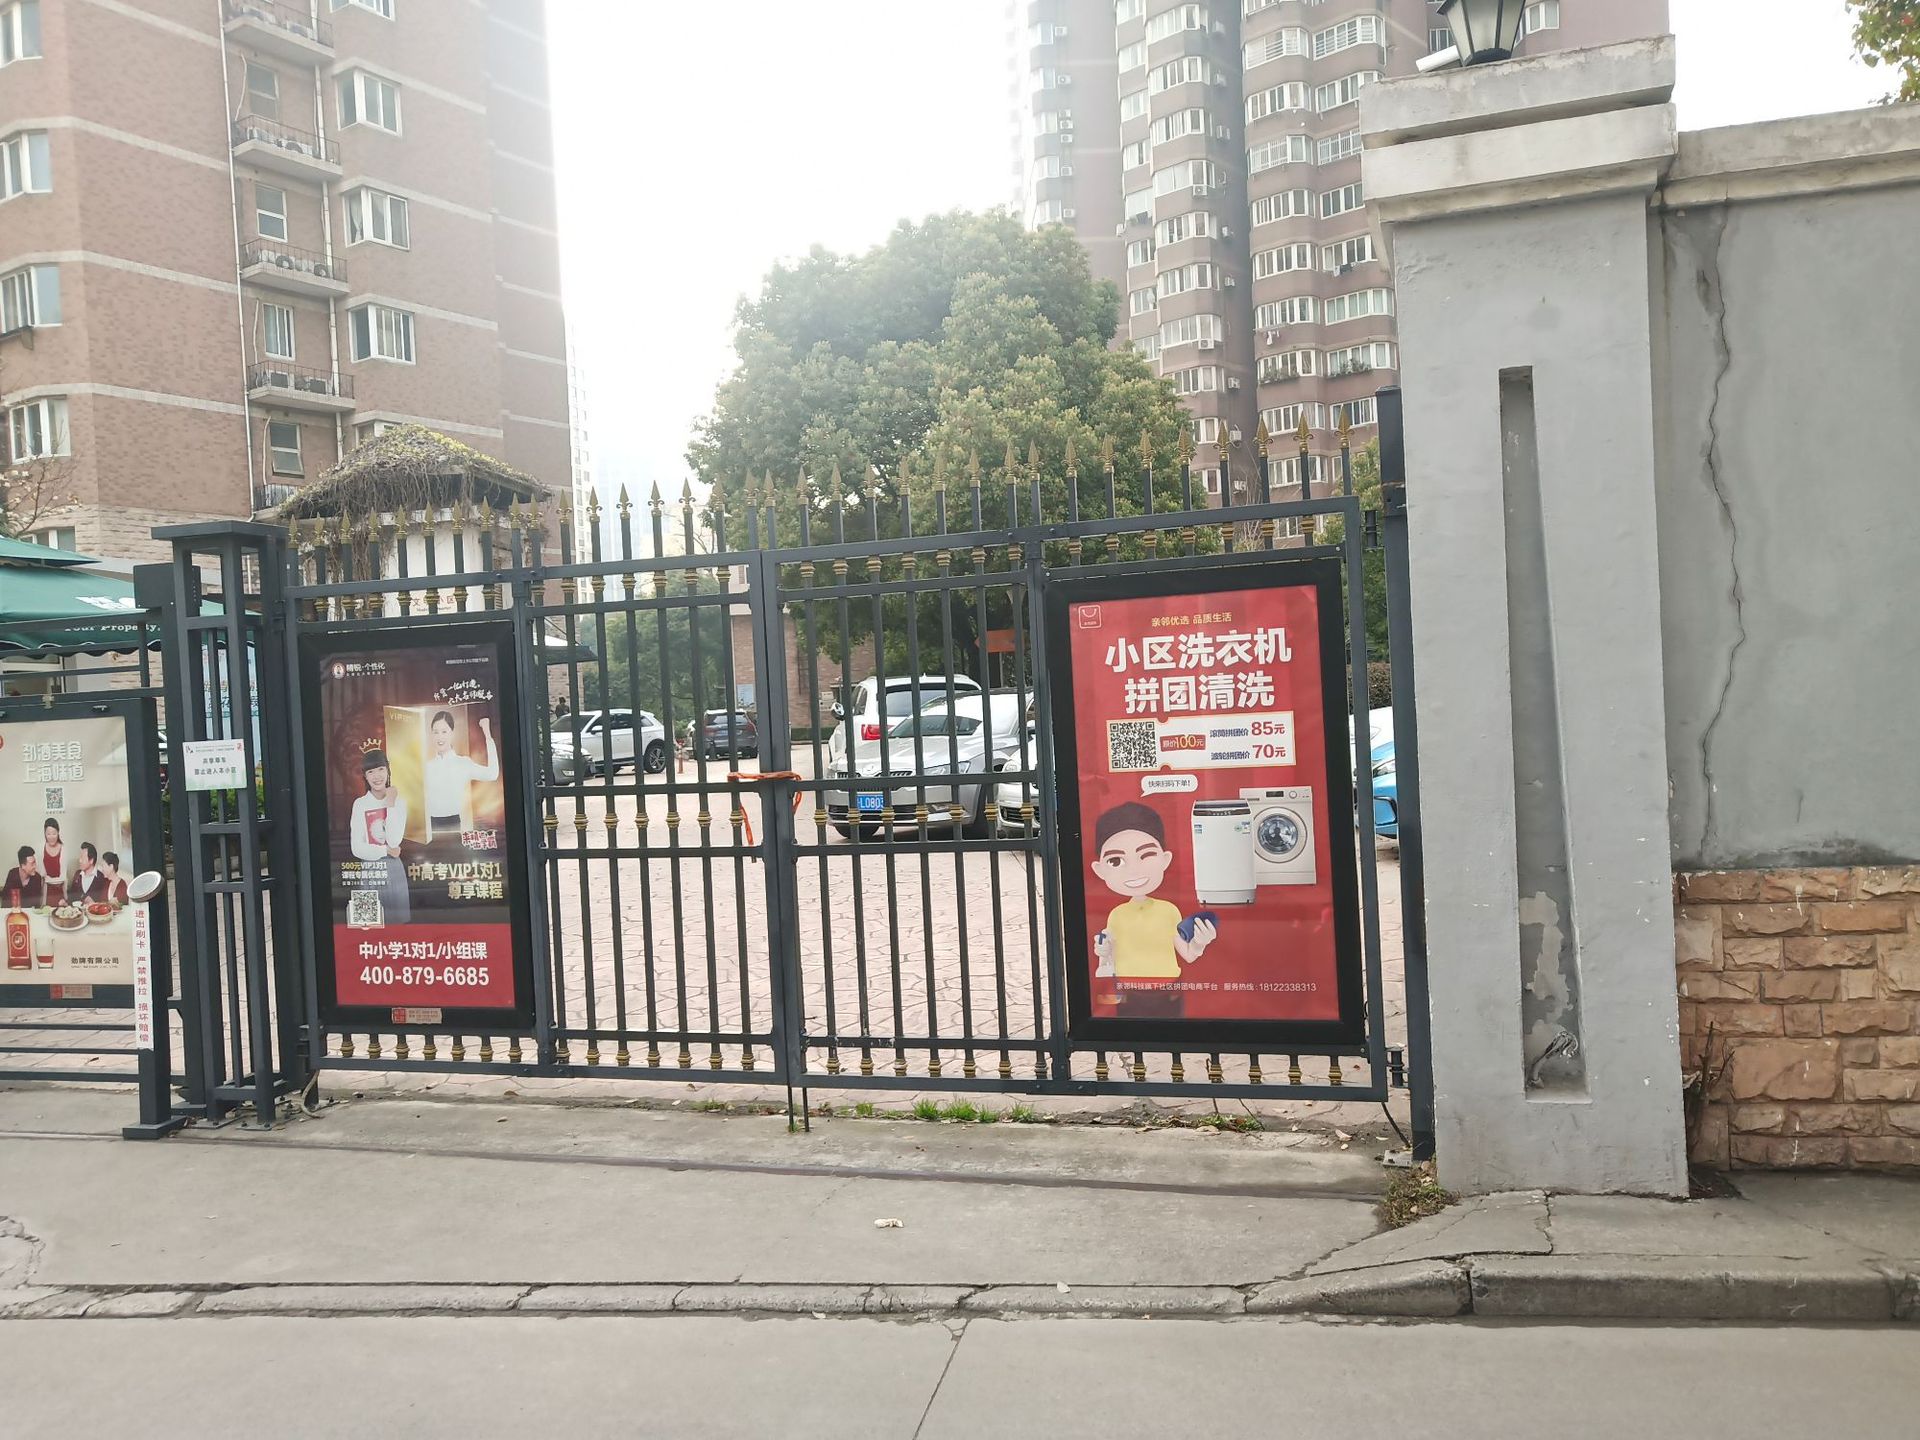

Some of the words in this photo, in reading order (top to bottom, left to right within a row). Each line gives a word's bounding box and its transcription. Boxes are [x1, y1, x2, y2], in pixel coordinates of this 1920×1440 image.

[1151, 615, 1190, 627] 亲邻优选
[1193, 612, 1232, 624] 品质生活
[1105, 627, 1292, 672] 小区洗衣机
[1124, 671, 1275, 714] 拼团清洗
[1251, 721, 1285, 736] 85元
[22, 741, 82, 763] 劲酒美食
[1252, 744, 1286, 759] 70元
[23, 763, 84, 784] 上海味道
[408, 862, 503, 881] 中高考VIP1对1
[448, 880, 503, 899] 尊享课程
[135, 910, 146, 949] 进出刷卡
[359, 941, 488, 960] 中小学1对1/小组课
[71, 957, 119, 965] 劲牌有限公司
[360, 966, 490, 986] 400-879-6685
